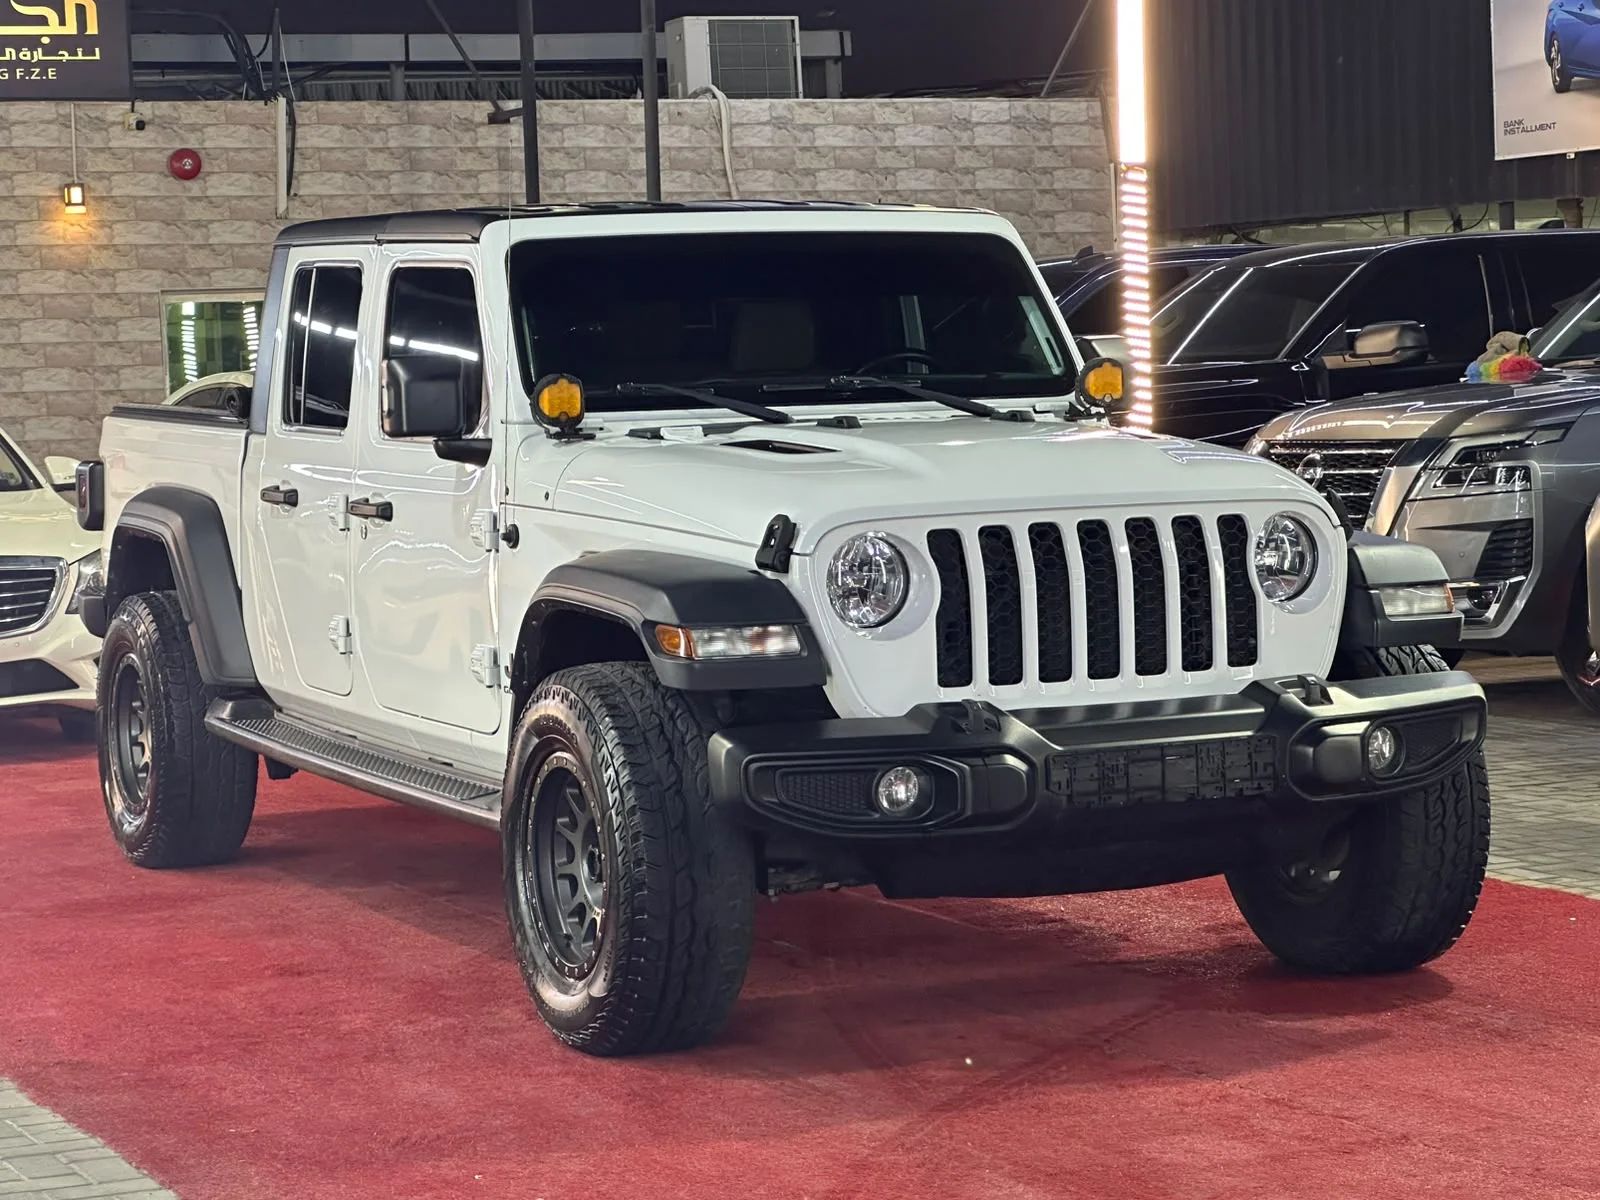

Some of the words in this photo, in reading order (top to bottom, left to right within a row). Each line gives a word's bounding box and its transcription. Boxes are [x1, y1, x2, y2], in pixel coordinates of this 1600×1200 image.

[0, 68, 9, 79] G
[15, 68, 57, 79] F.Z.E
[1503, 118, 1525, 128] BANK
[1503, 121, 1557, 136] INSTALLMENT
